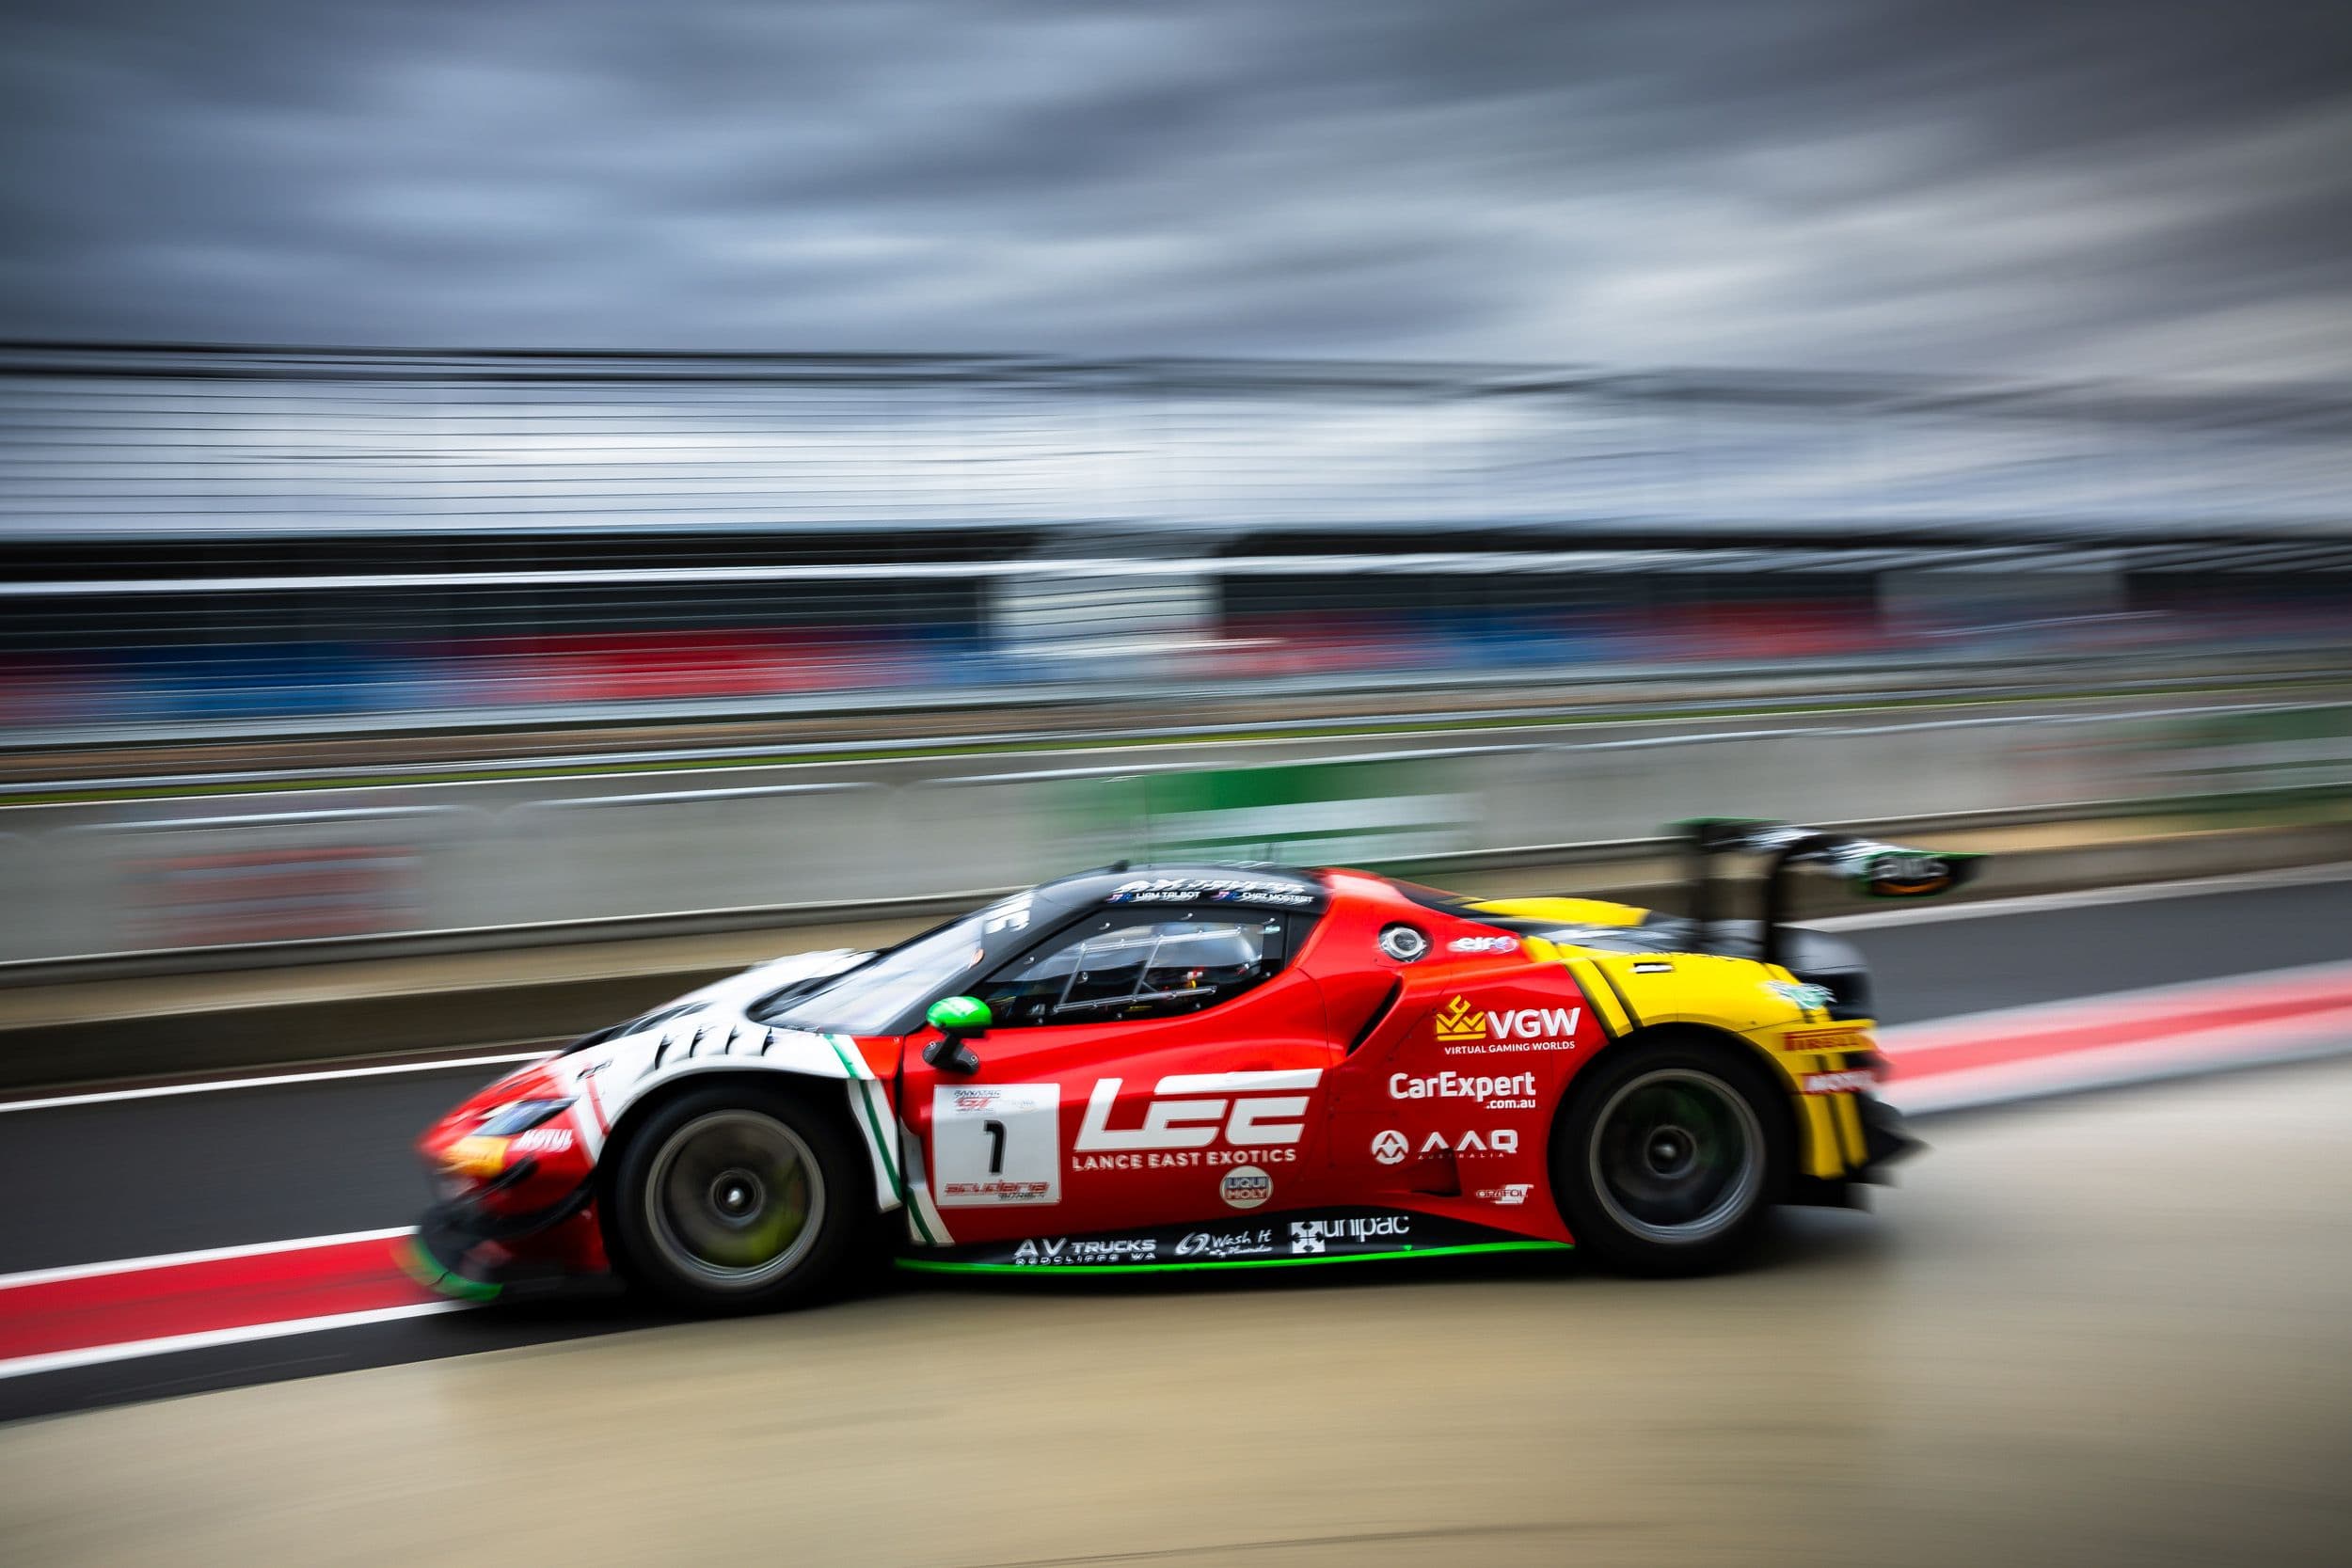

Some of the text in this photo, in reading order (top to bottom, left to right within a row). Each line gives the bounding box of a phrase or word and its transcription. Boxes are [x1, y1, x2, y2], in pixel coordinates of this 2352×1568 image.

[1487, 1007, 1581, 1039] VGW
[1445, 1041, 1575, 1054] VIRTUAL GAMING WORLDS
[1390, 1071, 1536, 1102] CarExpert
[1073, 1069, 1324, 1152] LEE
[1486, 1099, 1536, 1109] .com.au
[984, 1119, 1007, 1174] 1
[1073, 1148, 1296, 1171] LANCE EAST EXOTICS
[1228, 1177, 1266, 1188] LIQUI
[1227, 1188, 1266, 1199] MOLY
[1212, 1229, 1272, 1248] Wash It
[1325, 1216, 1409, 1243] unipac
[1013, 1238, 1156, 1258] AV TRUCKS
[1015, 1252, 1156, 1266] REDCLIFFE WA
